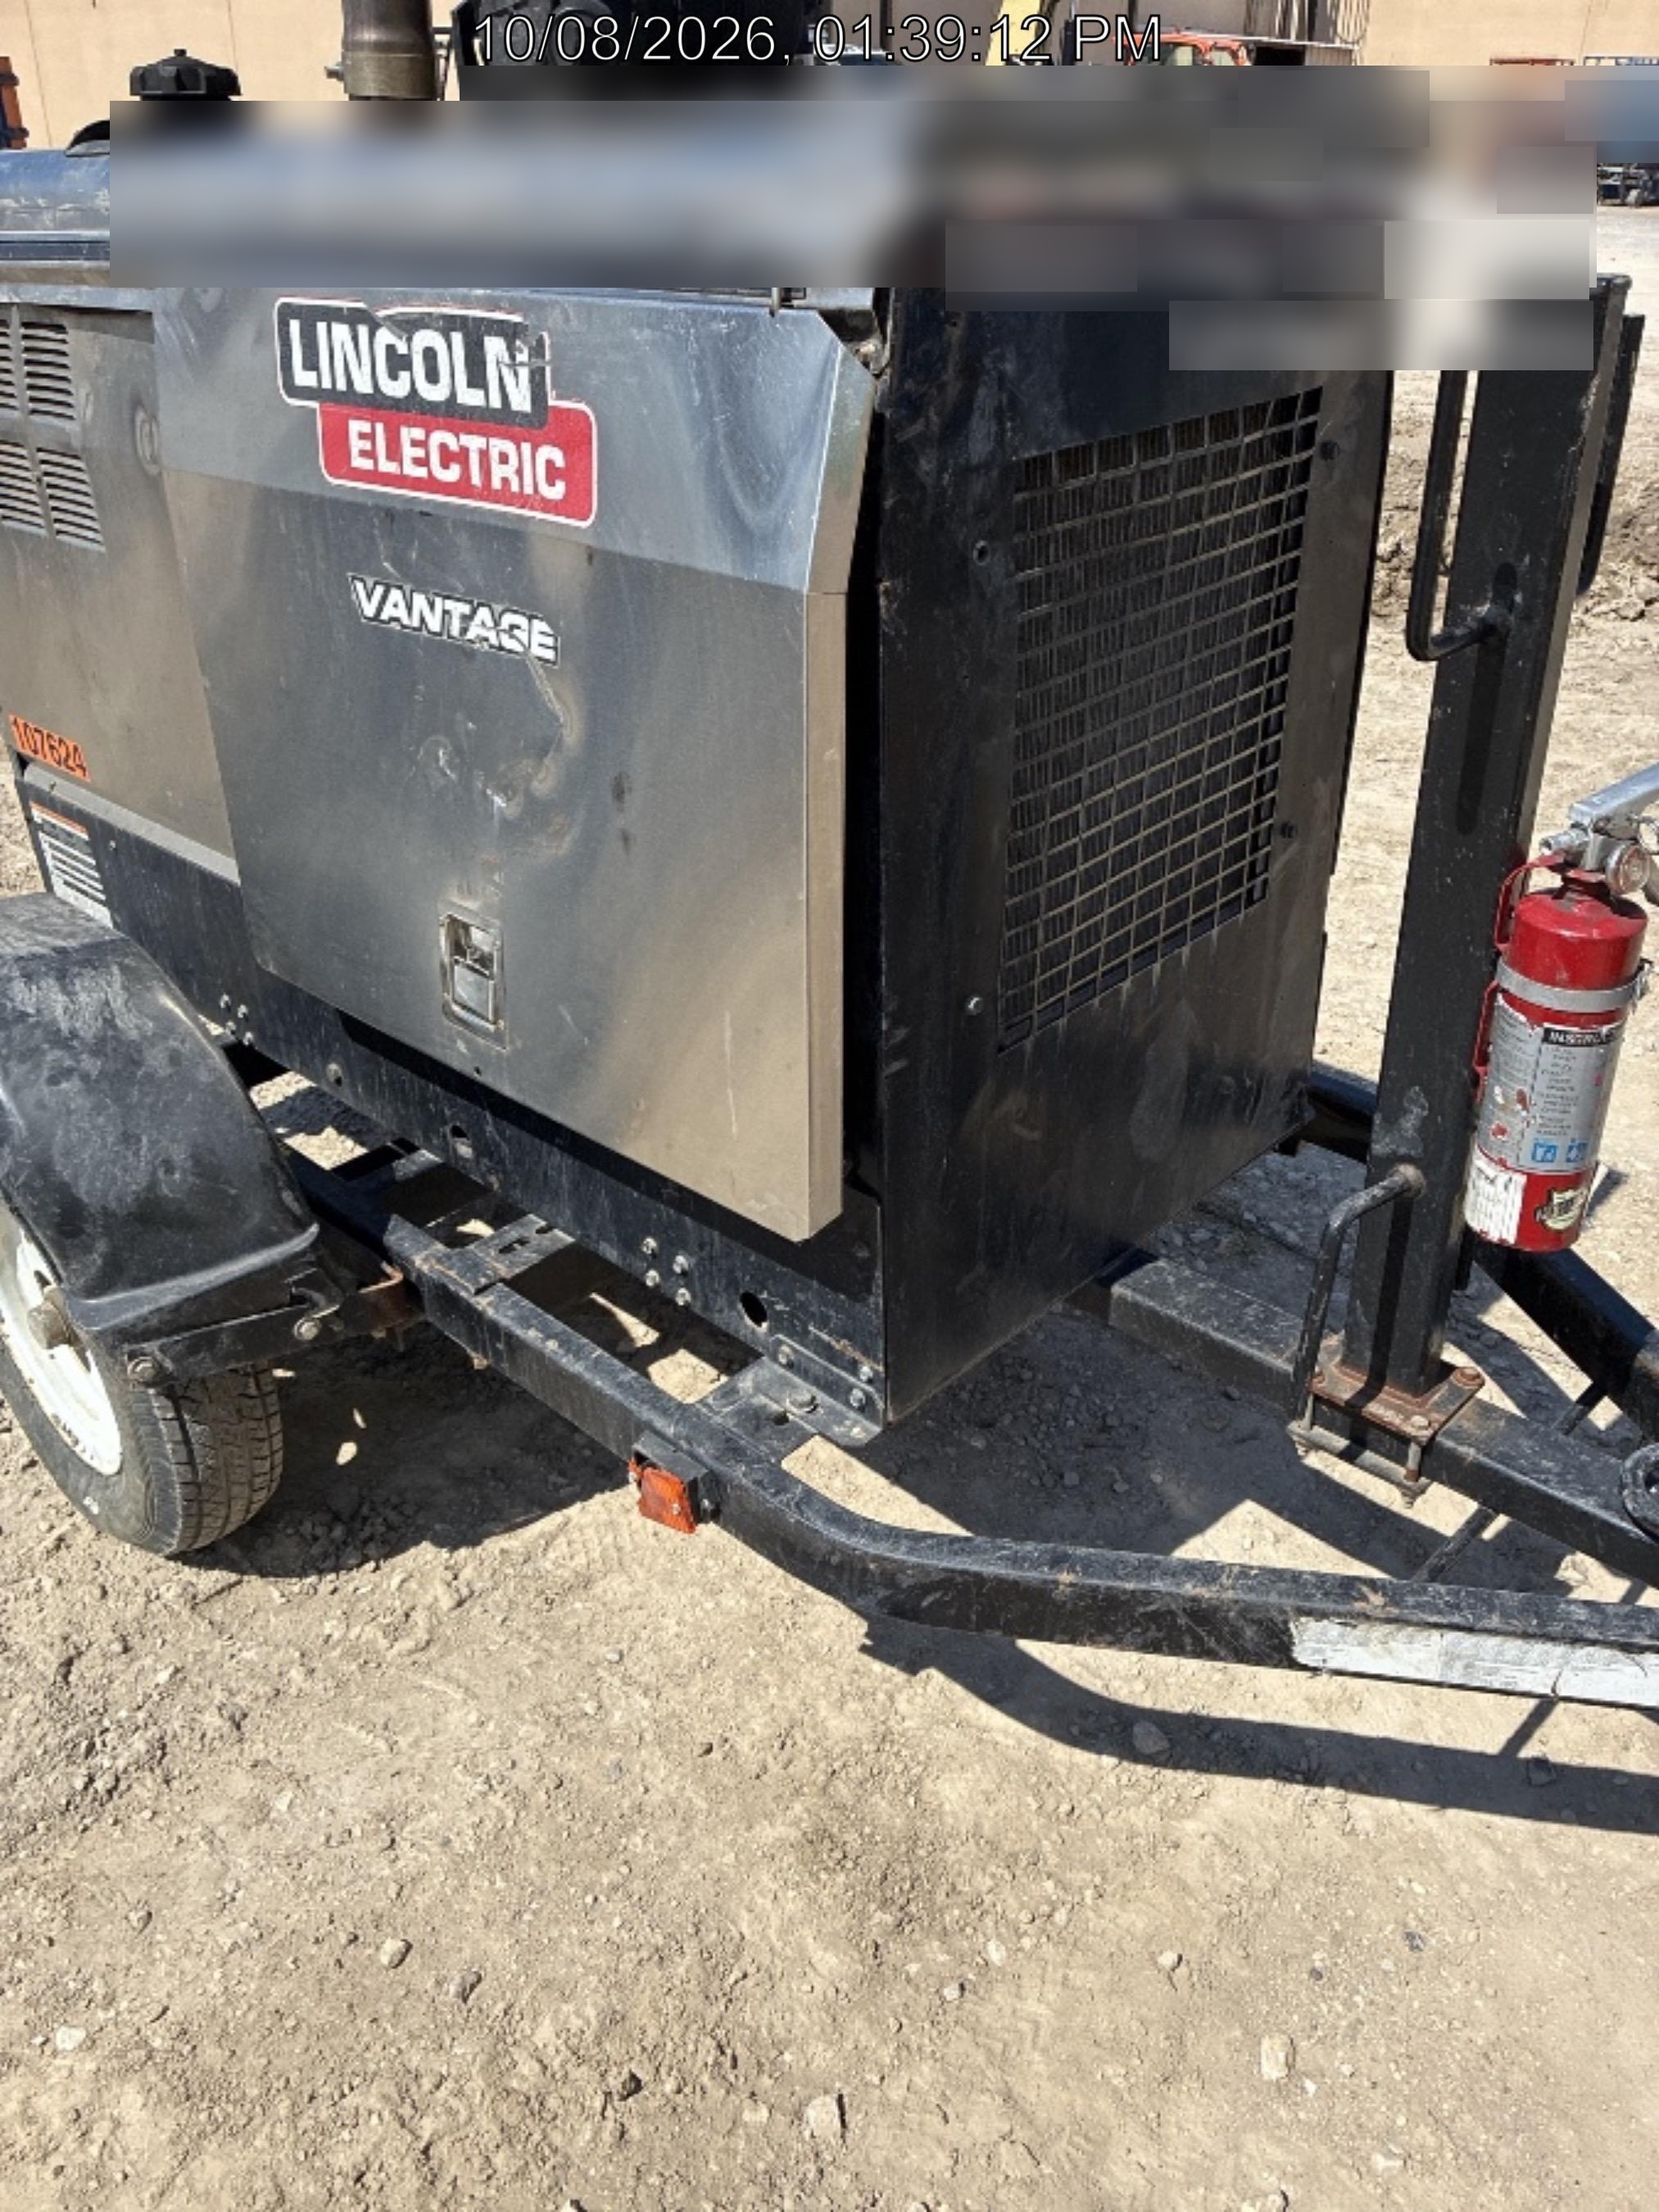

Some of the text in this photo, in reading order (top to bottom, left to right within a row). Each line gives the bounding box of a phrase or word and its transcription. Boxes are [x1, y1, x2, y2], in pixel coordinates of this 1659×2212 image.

[288, 318, 533, 414] LINCOLN
[347, 419, 567, 501] ELECTRIC
[350, 575, 559, 664] VANTAGE
[11, 716, 87, 777] 107624
